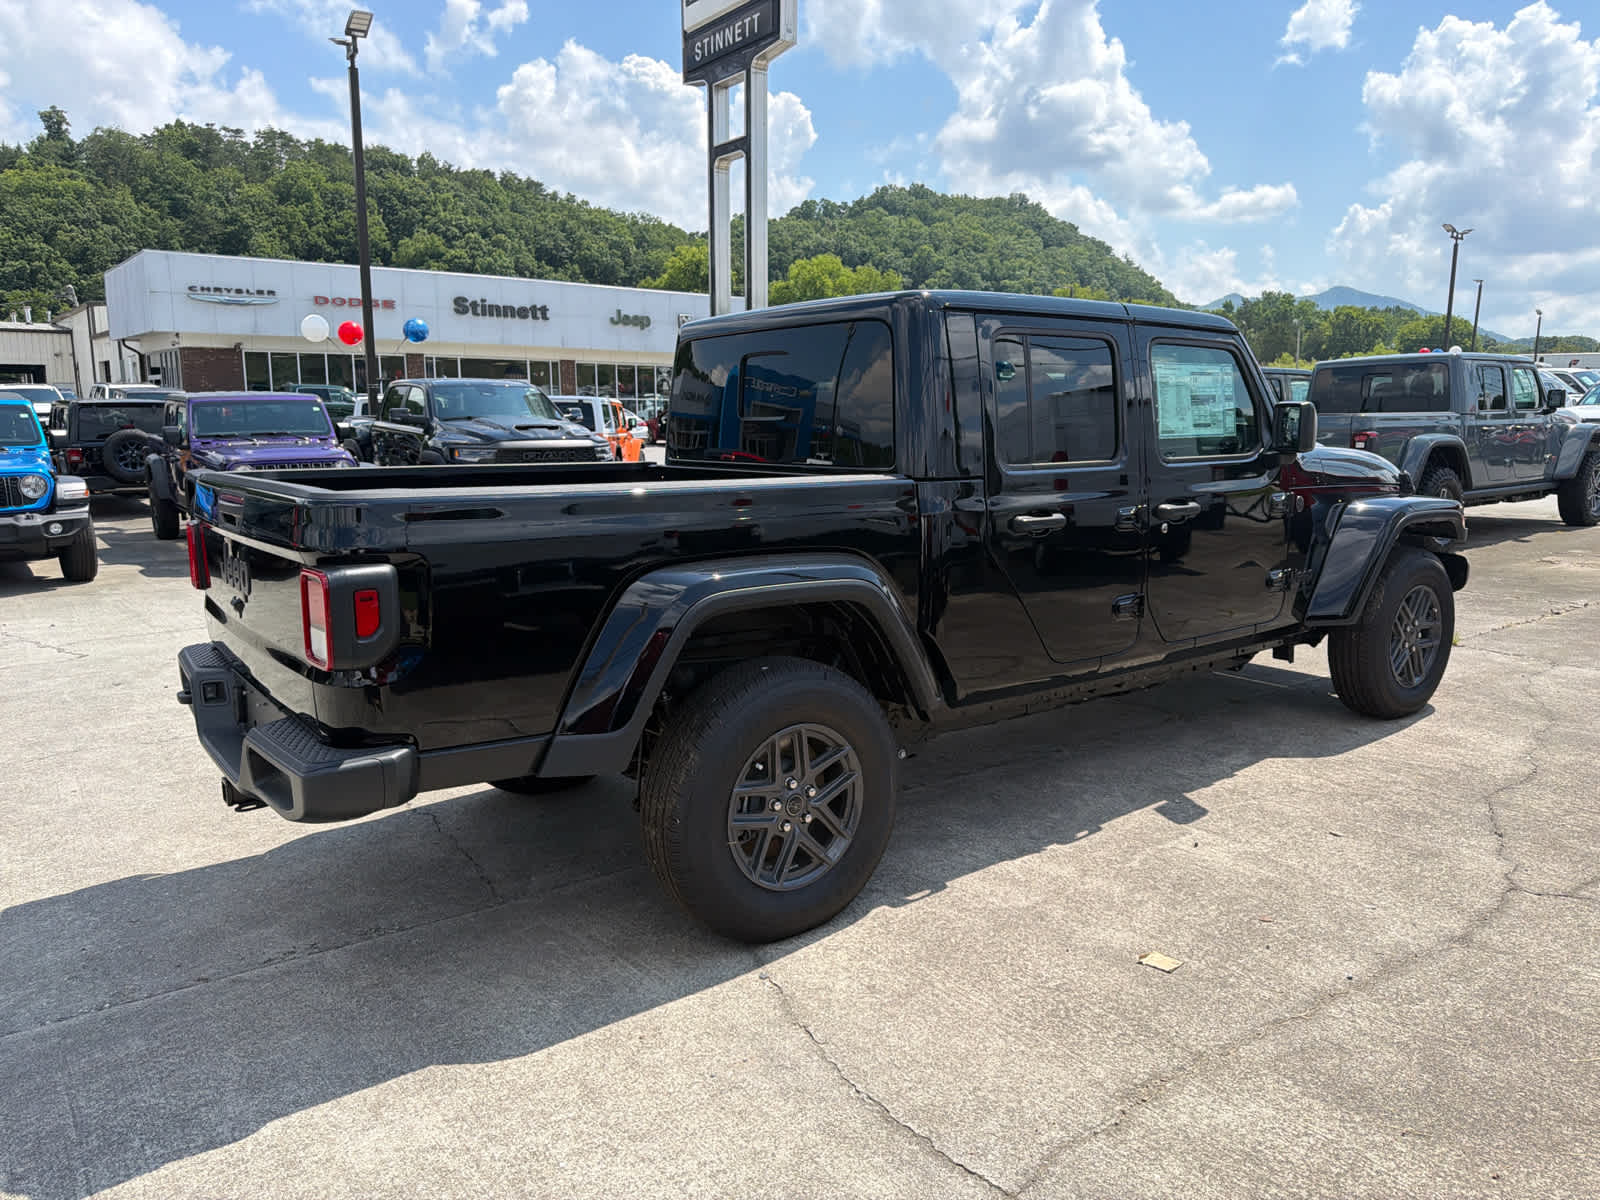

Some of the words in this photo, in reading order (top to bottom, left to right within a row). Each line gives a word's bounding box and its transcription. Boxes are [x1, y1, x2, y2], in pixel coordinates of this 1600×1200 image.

[694, 12, 760, 61] STINNETT
[188, 285, 276, 296] CHRYSLER
[453, 296, 550, 321] Stinnett
[609, 308, 651, 331] Jeep
